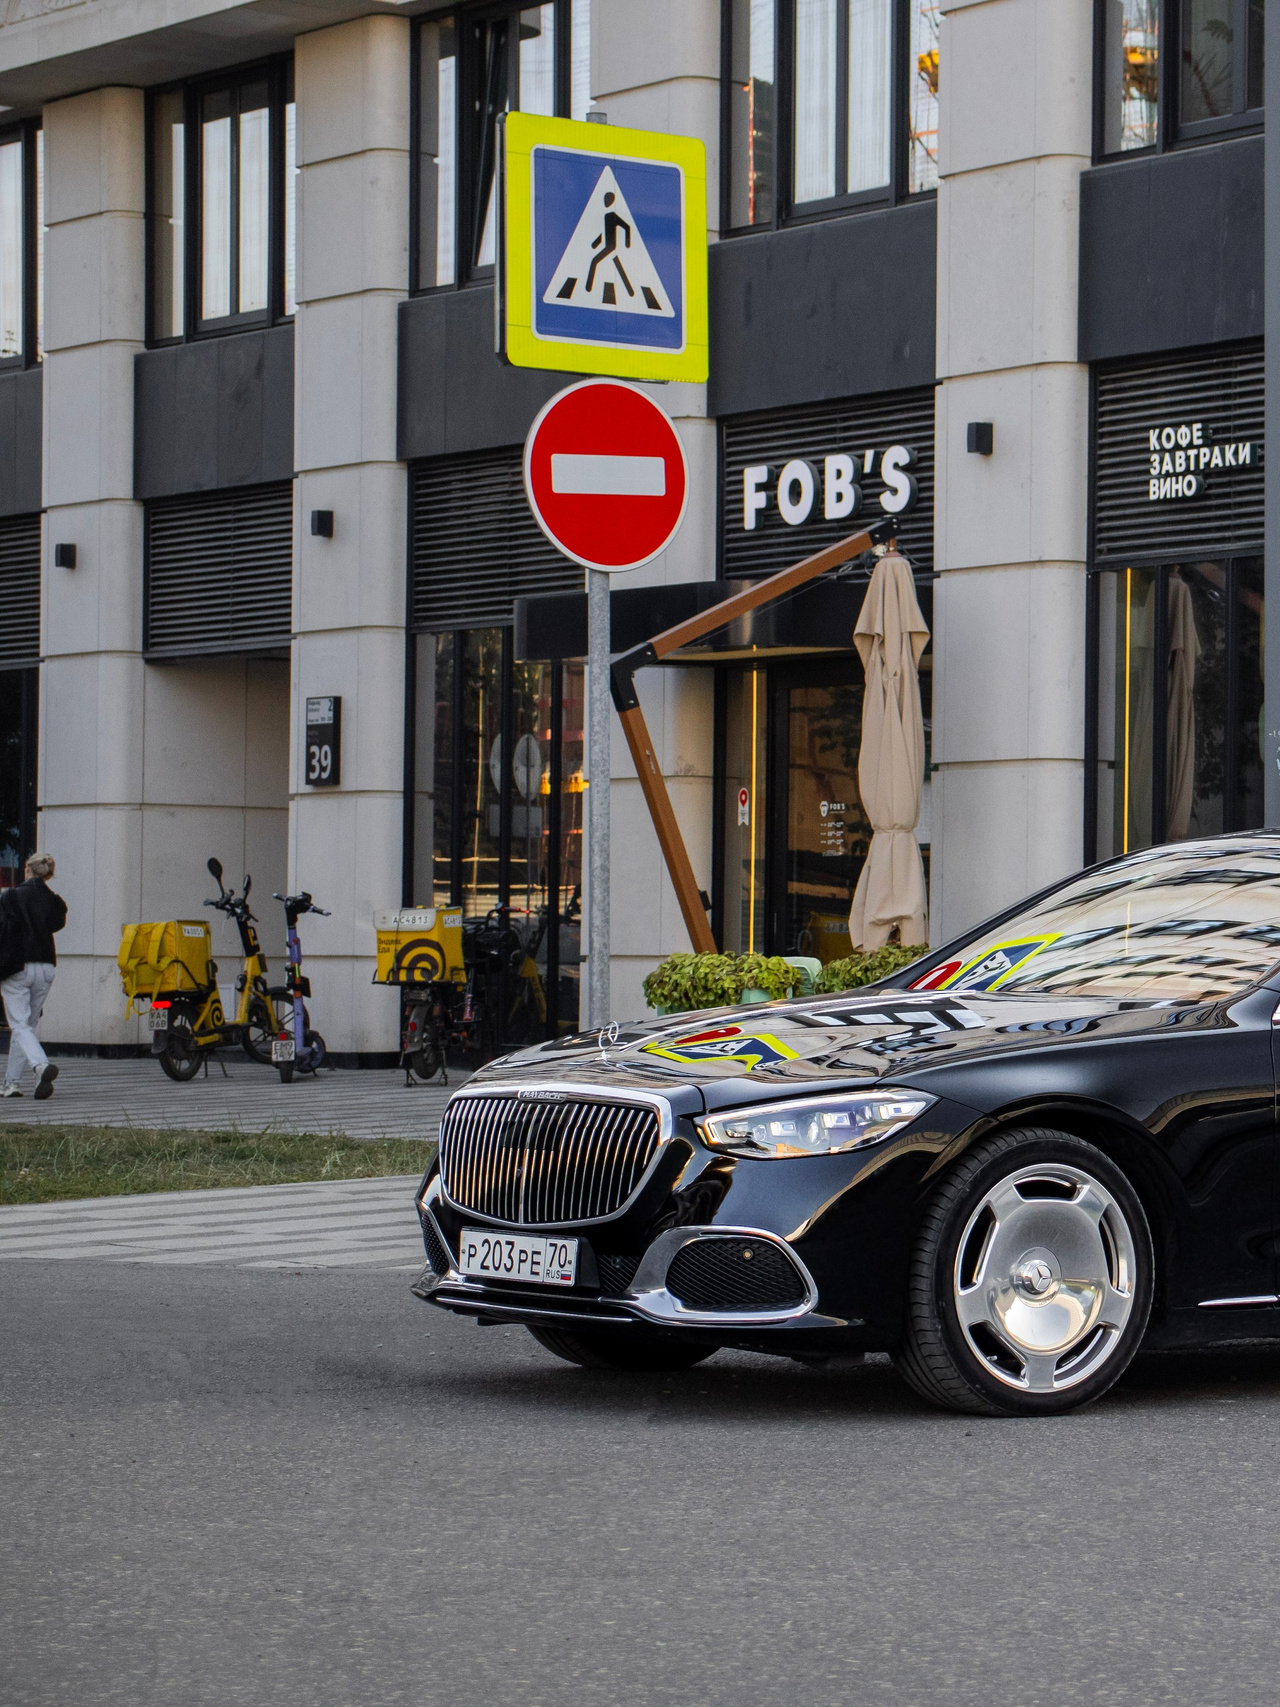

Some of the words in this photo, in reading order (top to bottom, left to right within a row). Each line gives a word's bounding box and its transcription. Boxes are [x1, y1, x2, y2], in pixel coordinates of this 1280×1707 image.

[1149, 423, 1203, 451] КОФЕ
[1149, 442, 1251, 476] ЗАВТРАКИ
[743, 445, 912, 531] FOB'S
[1149, 474, 1198, 500] ВИНО
[309, 744, 332, 780] 39
[522, 1091, 560, 1100] MAYBACH
[549, 1242, 568, 1269] 70
[546, 1269, 560, 1280] RUS
